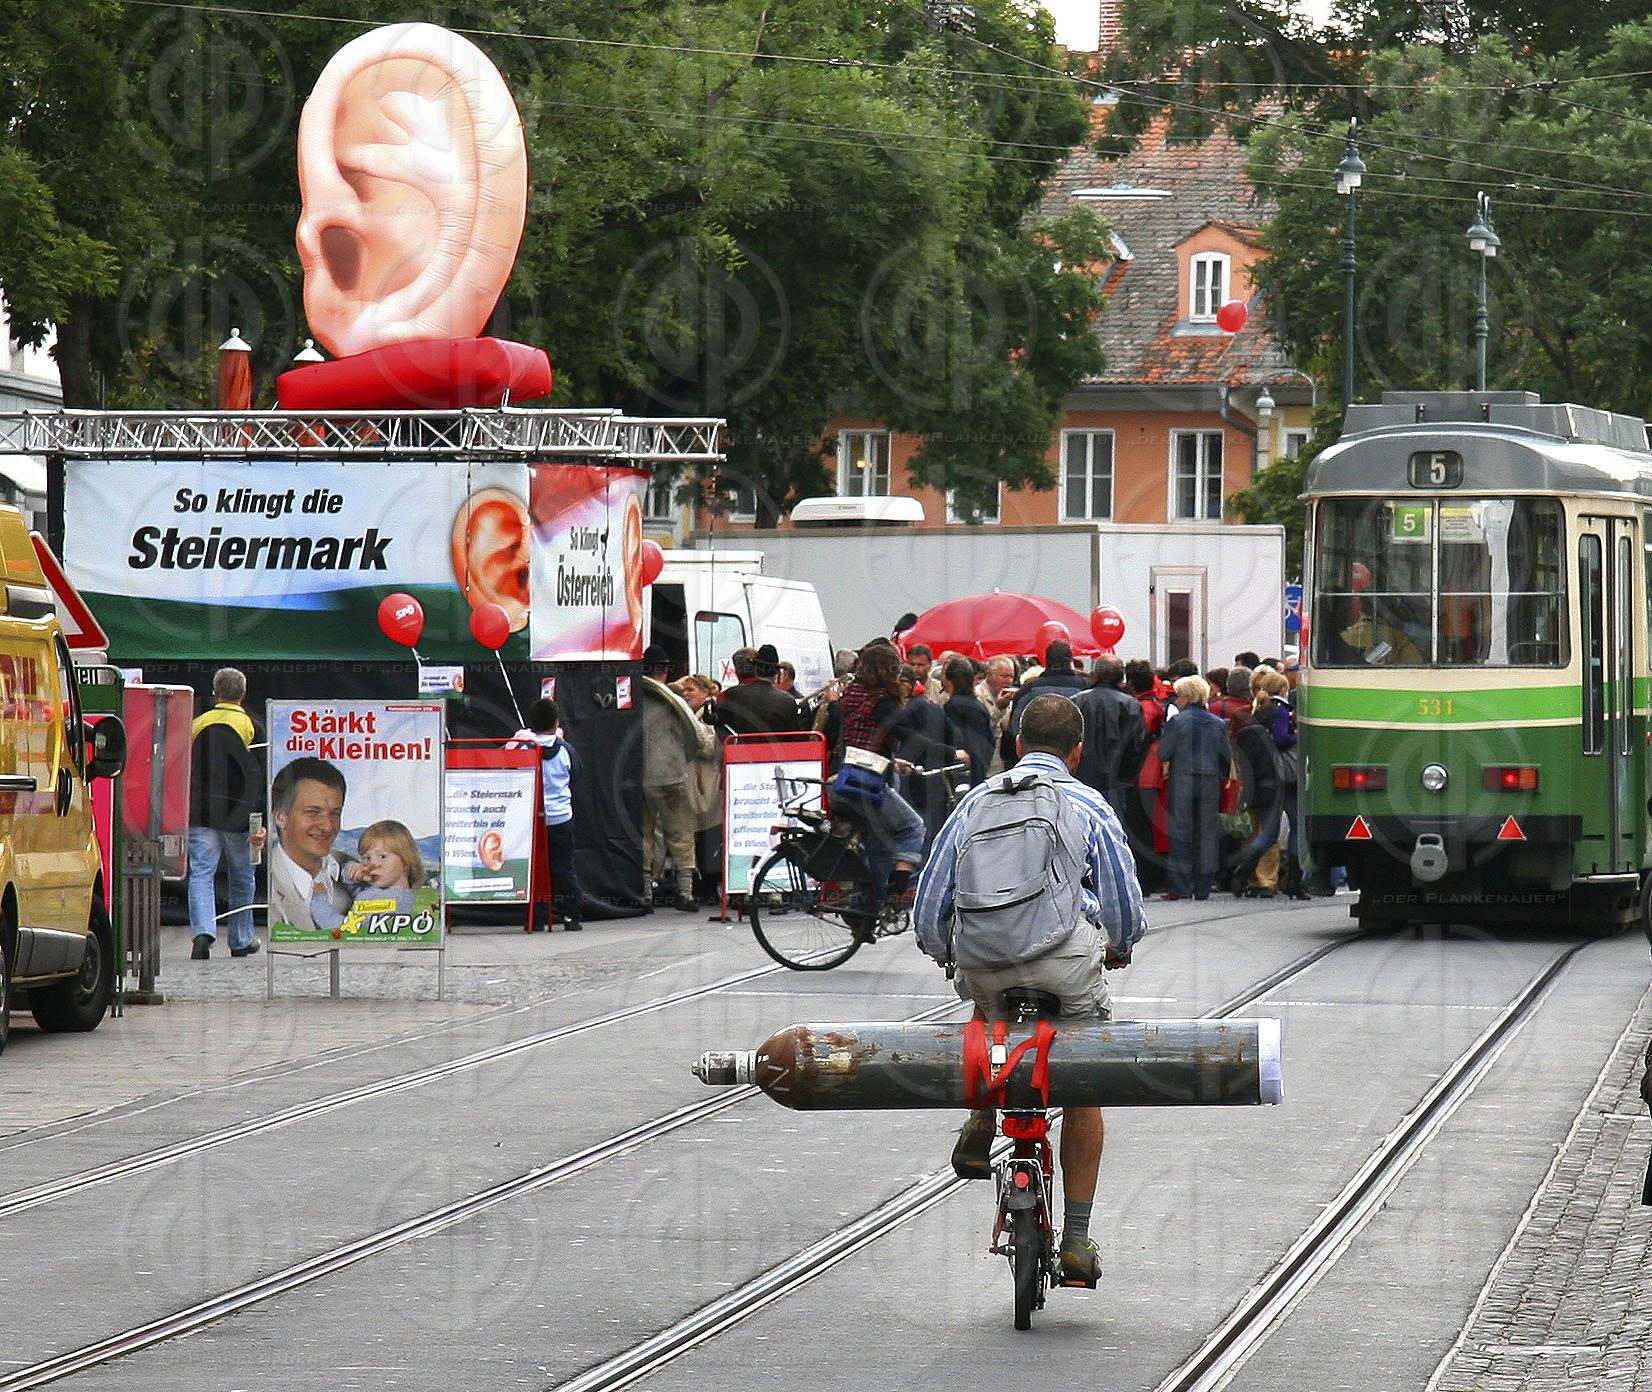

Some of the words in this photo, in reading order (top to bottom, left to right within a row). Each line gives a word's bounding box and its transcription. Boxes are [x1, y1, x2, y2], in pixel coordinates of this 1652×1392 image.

[1430, 454, 1445, 484] 5
[173, 488, 208, 513] So
[215, 488, 295, 519] klingt
[301, 488, 344, 513] die
[1403, 513, 1416, 532] 5
[127, 525, 393, 570] Steiermark
[570, 526, 578, 550] So
[556, 554, 614, 606] Österreich
[1418, 698, 1454, 716] 531
[290, 708, 376, 733] Stärkt
[286, 736, 316, 752] die
[319, 737, 433, 760] Kleinen!
[470, 789, 523, 799] Steiermark
[482, 804, 507, 814] auch
[490, 819, 506, 829] ein
[368, 910, 435, 935] KPÖ
